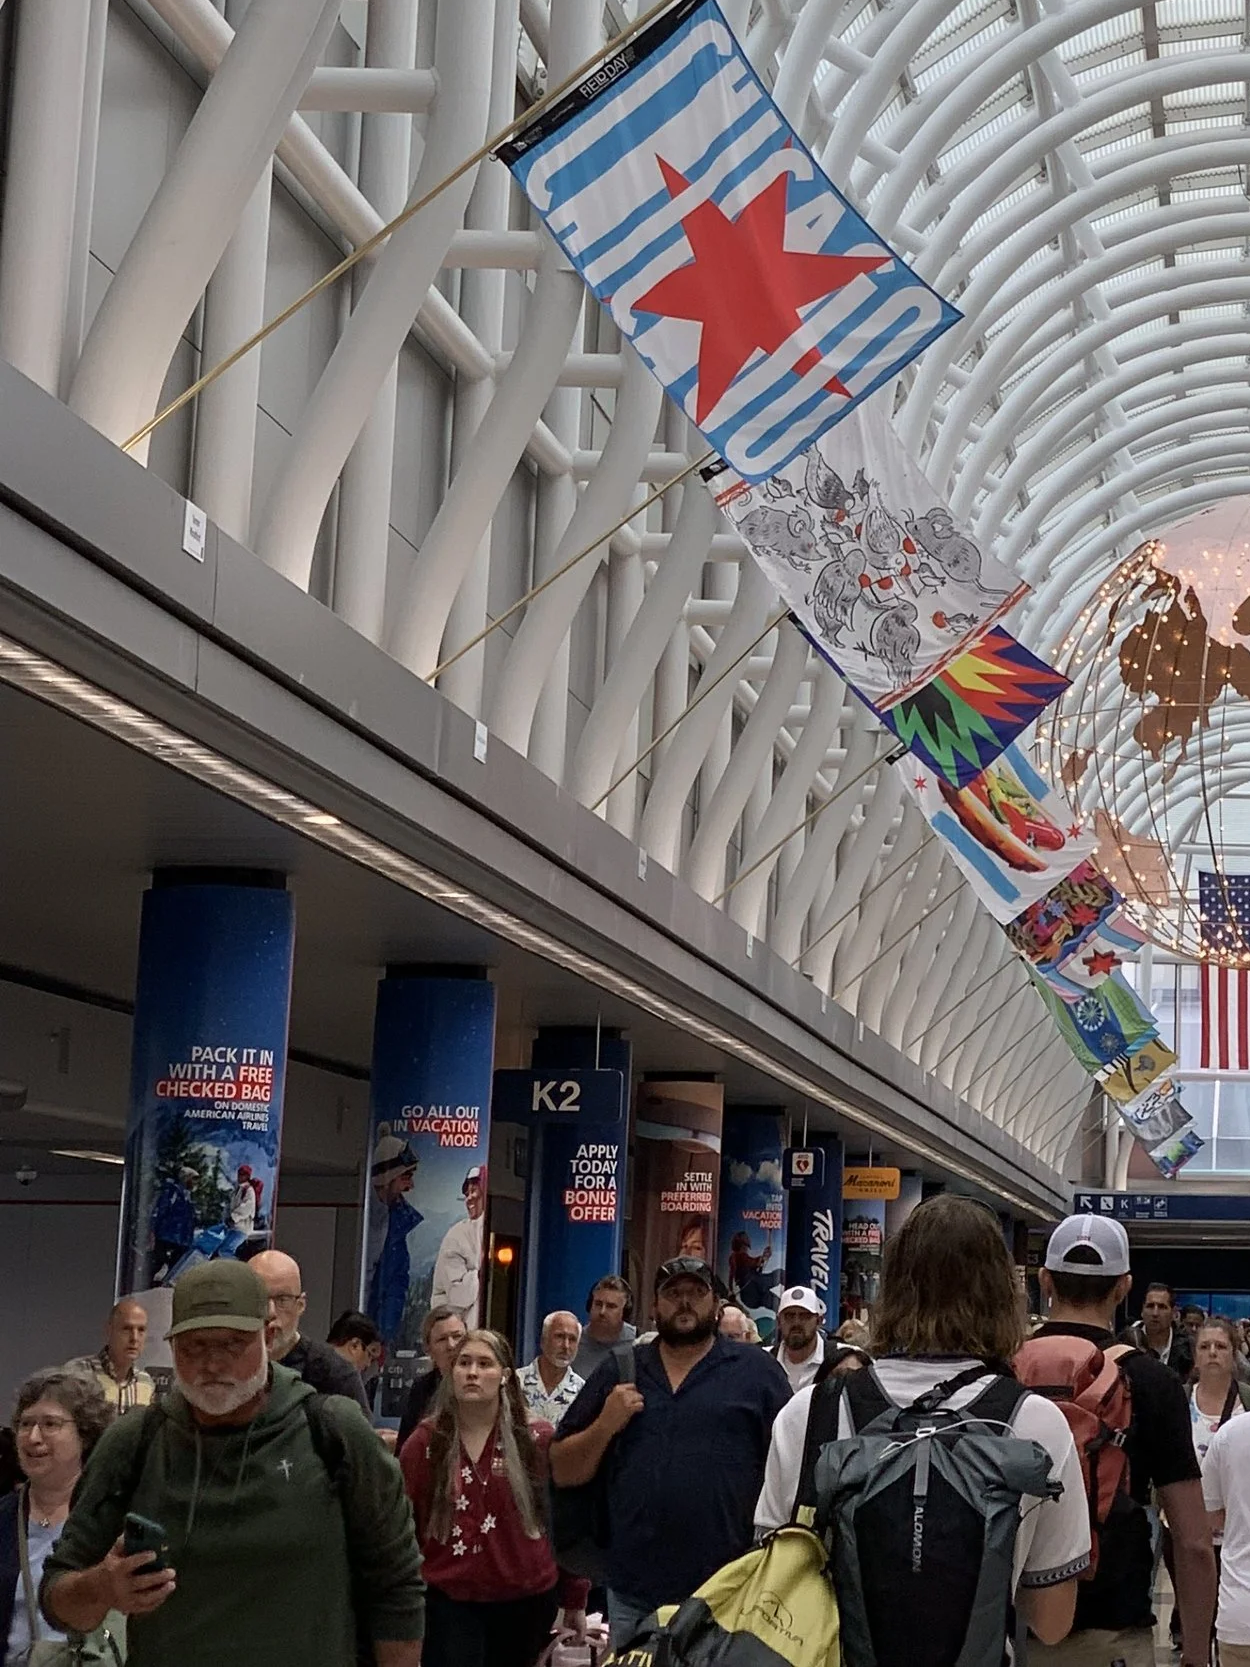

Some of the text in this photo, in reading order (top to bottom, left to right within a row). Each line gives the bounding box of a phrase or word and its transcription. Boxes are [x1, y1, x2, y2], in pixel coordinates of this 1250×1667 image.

[579, 71, 609, 99] FIELD
[605, 53, 628, 78] DAY
[191, 1045, 274, 1066] PACK IT IN
[169, 1063, 272, 1084] WITH A FREE
[156, 1081, 271, 1102] CHECKED BAG
[532, 1080, 581, 1112] K2
[214, 1101, 270, 1113] ON DOMESTIC
[401, 1105, 480, 1119] GO ALL OUT
[184, 1110, 269, 1123] AMERICAN AIRLINES
[242, 1121, 268, 1132] TRAVEL
[393, 1119, 479, 1133] IN VACATION
[440, 1134, 478, 1147] MODE
[576, 1144, 618, 1159] APPLY
[570, 1159, 618, 1174] TODAY
[574, 1175, 617, 1190] FOR A
[684, 1172, 712, 1182] SETTLE
[676, 1182, 712, 1192] IN WITH
[565, 1190, 616, 1206] BONUS
[661, 1192, 712, 1202] PREFERRED
[1121, 1199, 1128, 1209] K
[570, 1206, 615, 1221] OFFER
[660, 1202, 711, 1212] BOARDING
[742, 1211, 783, 1220] VACATION
[760, 1220, 782, 1229] MODE
[810, 1209, 834, 1291] TRAVEL
[912, 1506, 924, 1573] ALOMON
